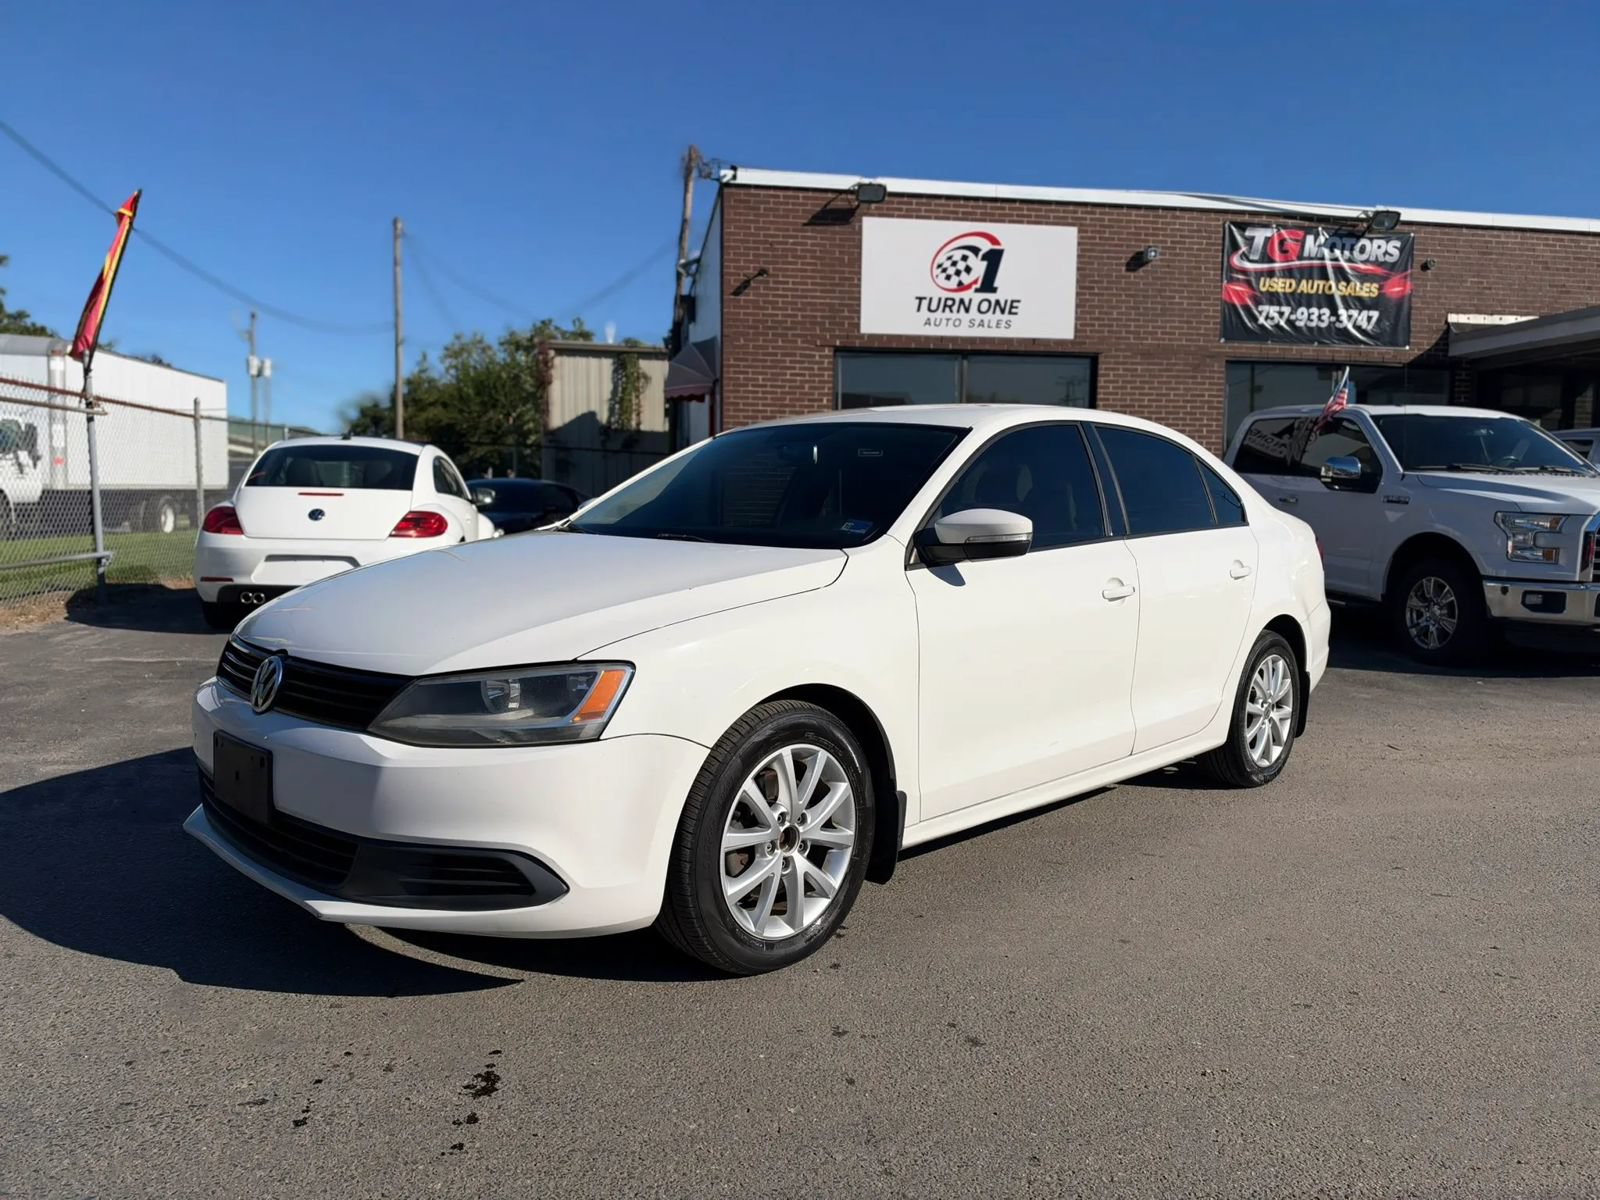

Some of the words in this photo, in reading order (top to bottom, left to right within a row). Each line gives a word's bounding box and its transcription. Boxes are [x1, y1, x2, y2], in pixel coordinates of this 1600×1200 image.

[1244, 227, 1305, 262] TG
[1304, 235, 1402, 263] MOTORS
[1259, 277, 1296, 293] USED
[1297, 279, 1334, 295] AUTO
[1337, 280, 1379, 298] SALES
[915, 296, 973, 314] TURN
[977, 298, 1021, 316] ONE
[923, 317, 962, 328] AUTO
[968, 318, 1013, 330] SALES
[1258, 305, 1380, 331] 757-933-3747
